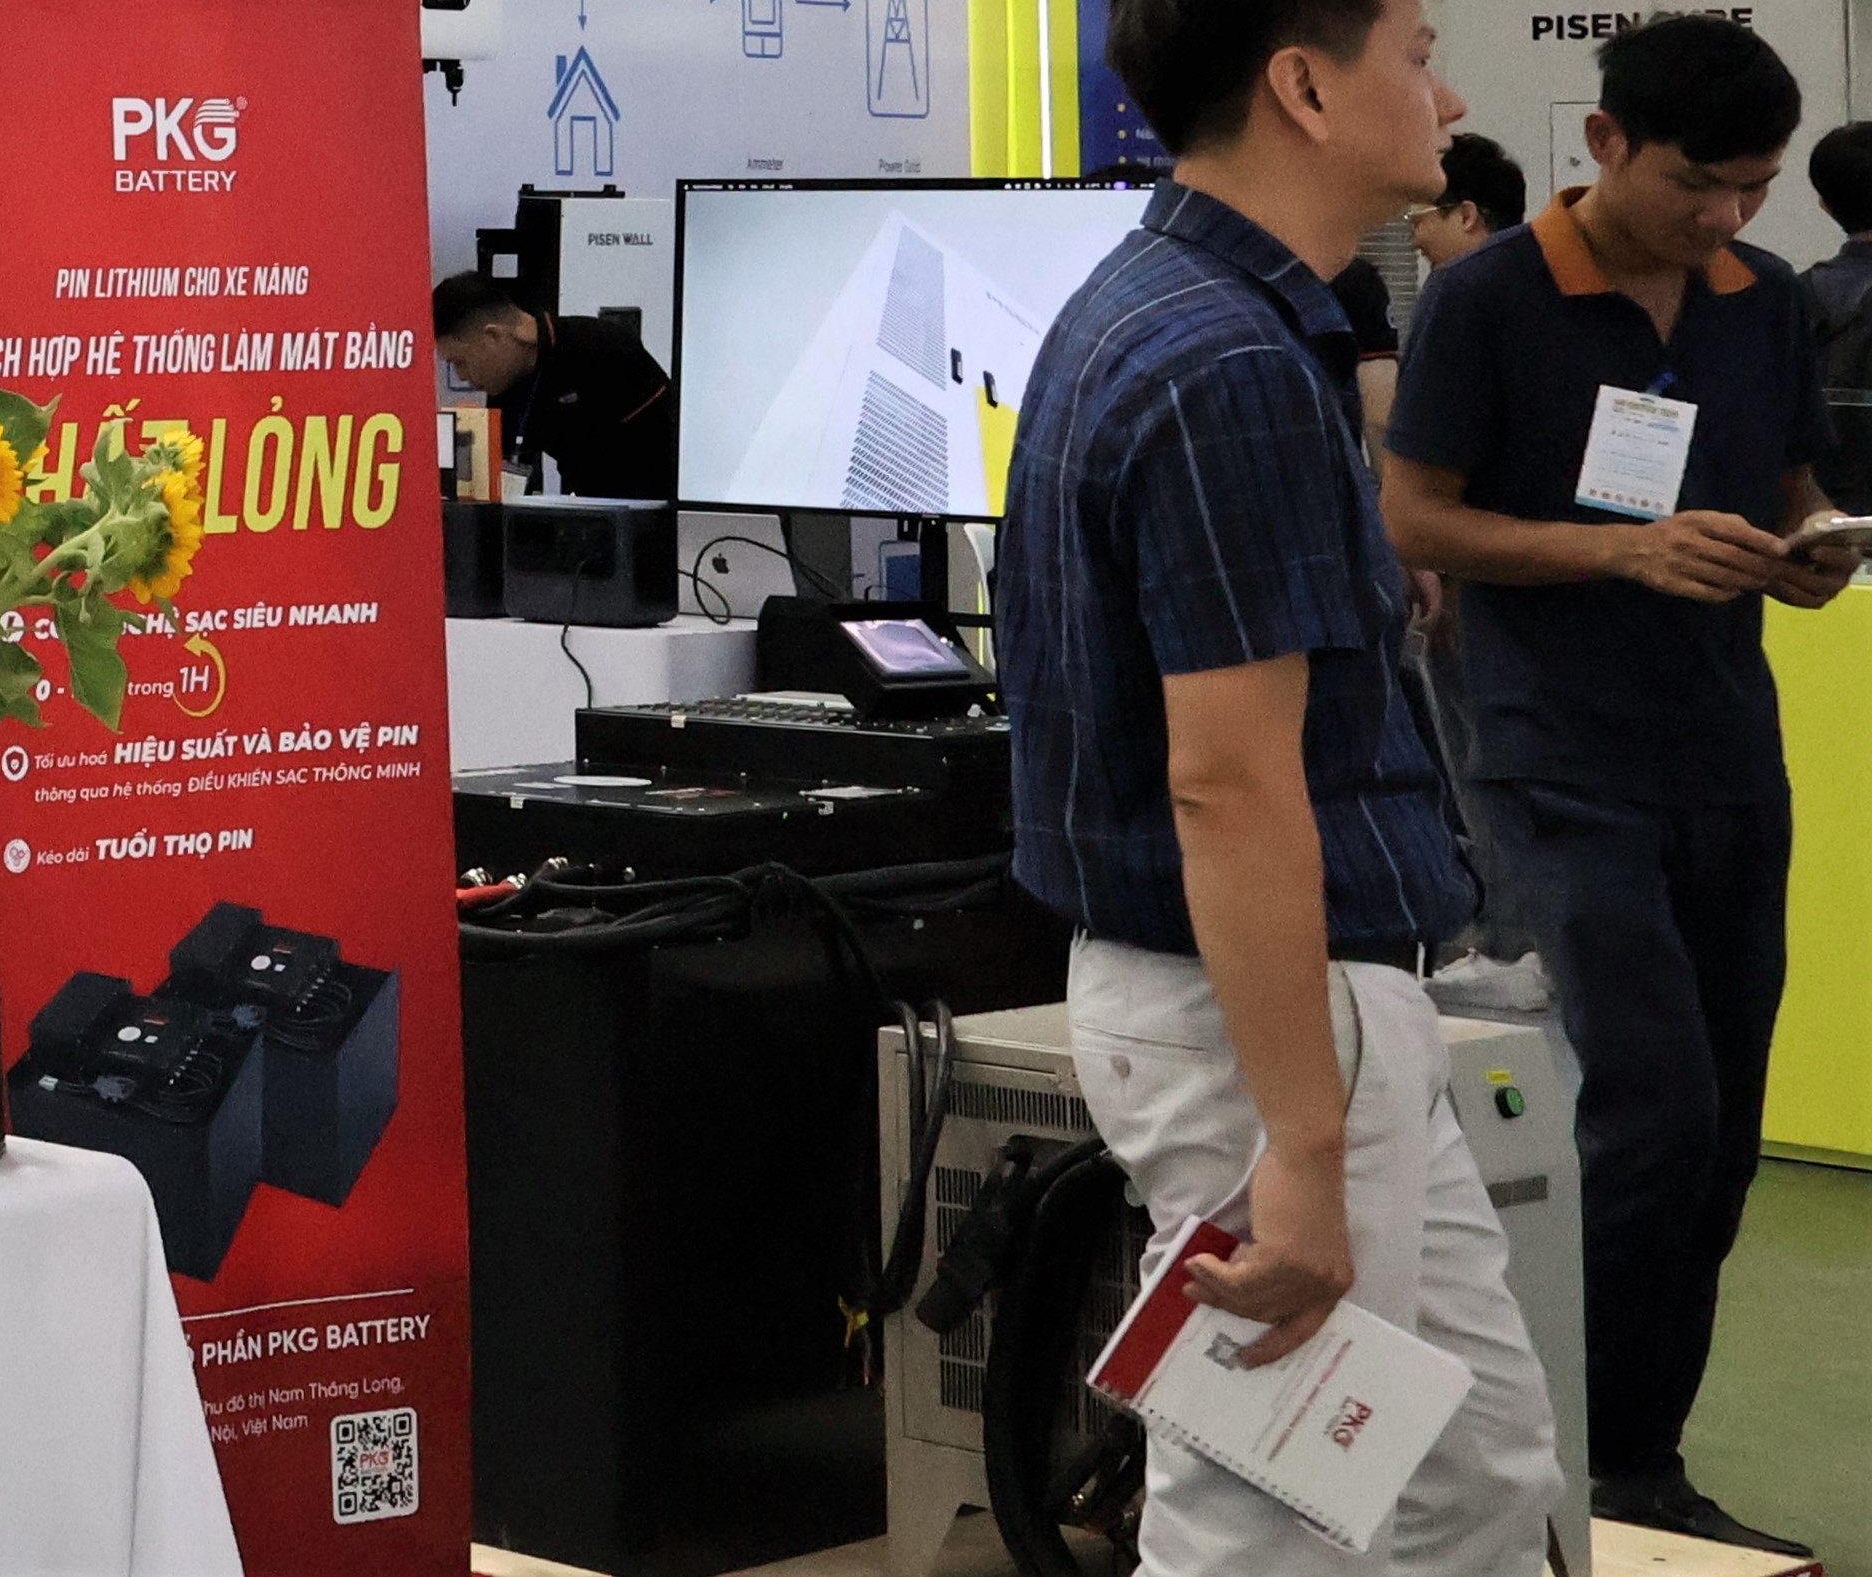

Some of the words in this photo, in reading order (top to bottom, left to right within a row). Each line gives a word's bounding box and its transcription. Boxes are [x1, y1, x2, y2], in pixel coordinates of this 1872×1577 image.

[112, 97, 241, 162] PKG
[116, 170, 236, 191] BATTERY
[587, 232, 620, 246] PISEN
[623, 232, 654, 246] WALL
[57, 269, 89, 297] PIN
[96, 268, 179, 297] LITHIUM
[185, 268, 219, 296] CHO
[224, 267, 249, 295] XE
[254, 267, 308, 294] NÂNG
[28, 335, 81, 376] HỢP
[87, 331, 124, 375] HỆ
[134, 330, 215, 373] THỐNG
[221, 333, 273, 371] LÀM
[280, 332, 339, 370] MÁT
[345, 323, 413, 369] BẰNG
[202, 395, 404, 535] LỎNG
[185, 610, 227, 636] SẠC
[234, 602, 282, 629] SIÊU
[289, 603, 377, 625] NHANH
[128, 679, 174, 698] trong
[180, 665, 209, 693] 1H
[115, 736, 175, 767] HIỆU
[181, 729, 238, 760] SUẤT
[243, 728, 271, 754] VÀ
[279, 723, 332, 752] BẢO
[340, 722, 371, 753] VỆ
[377, 725, 418, 746] PIN
[96, 828, 156, 859] TUỔI
[164, 833, 212, 858] THỌ
[218, 829, 252, 851] PIN
[203, 1329, 261, 1367] PHẦN
[269, 1327, 318, 1355] PKG
[327, 1315, 430, 1349] BATTERY
